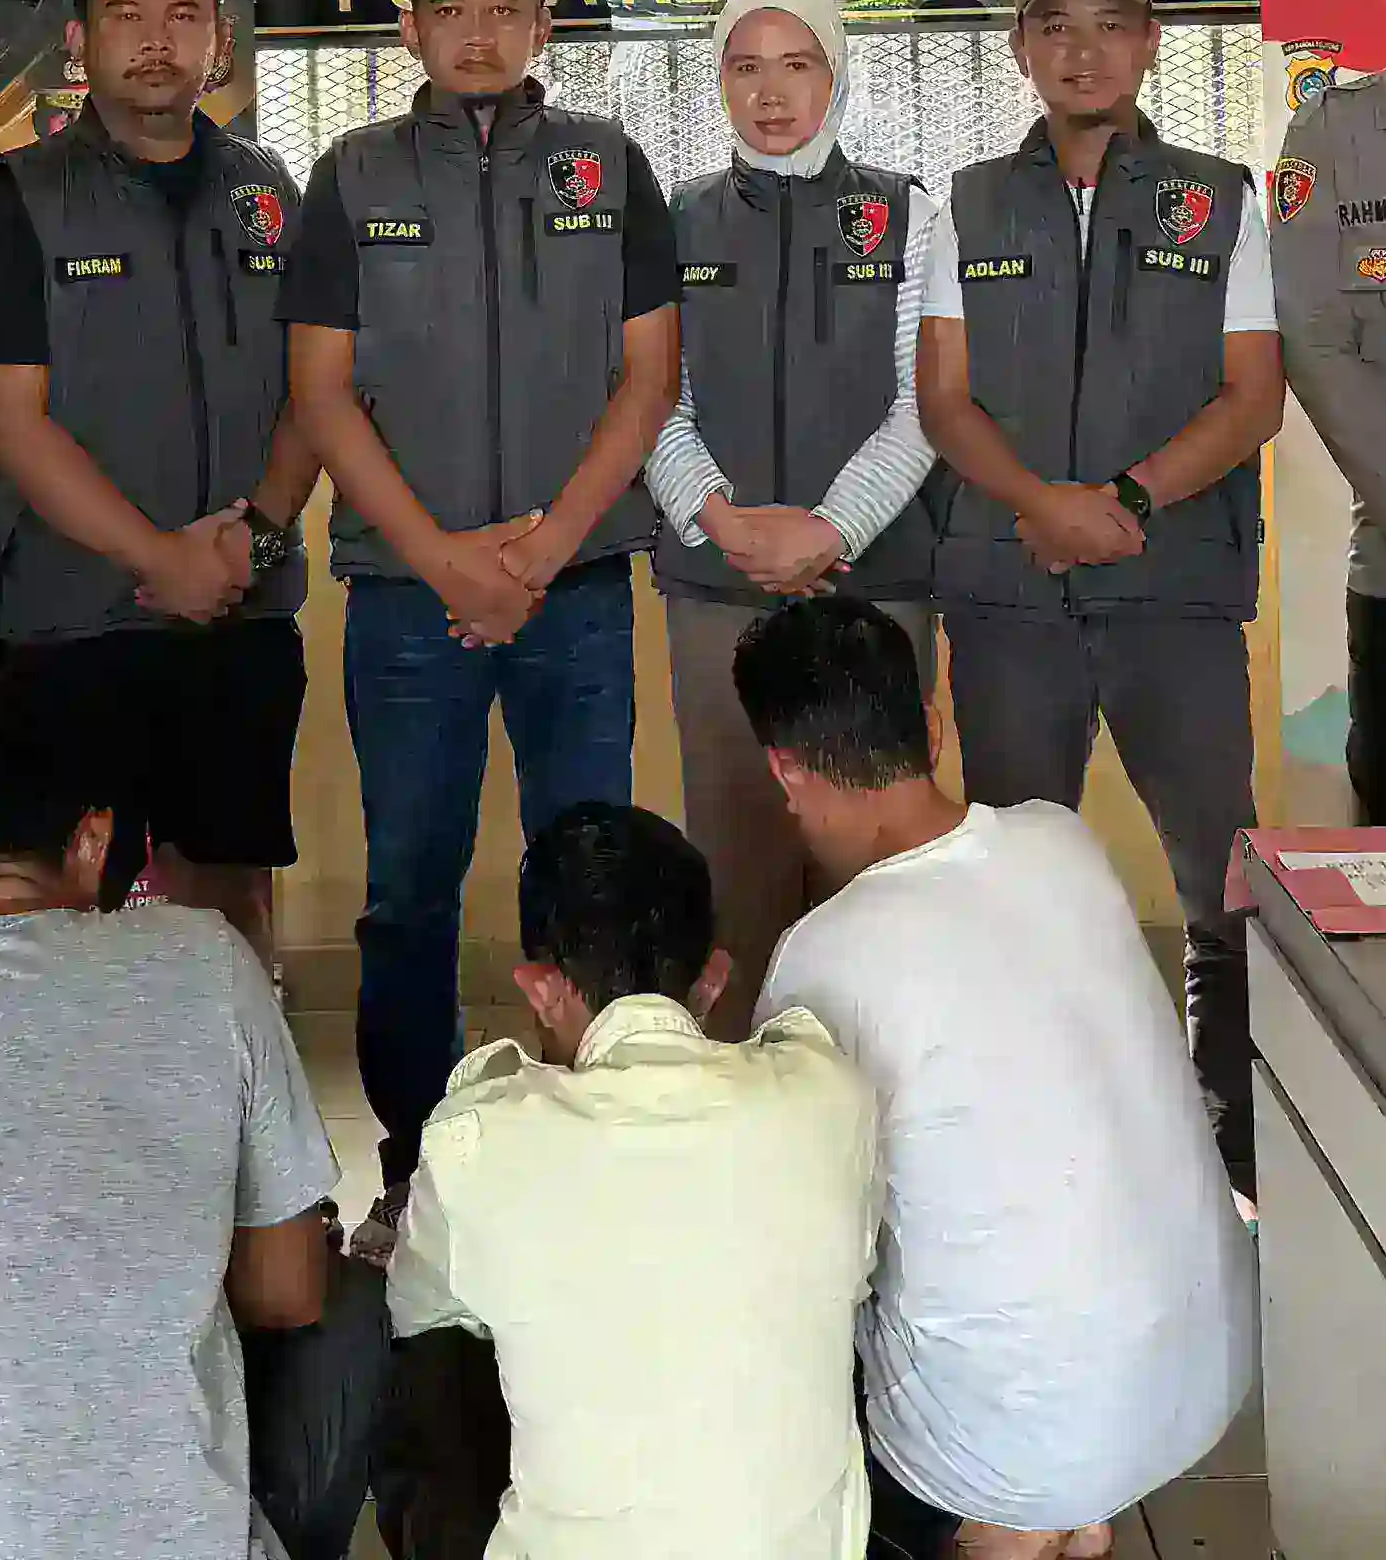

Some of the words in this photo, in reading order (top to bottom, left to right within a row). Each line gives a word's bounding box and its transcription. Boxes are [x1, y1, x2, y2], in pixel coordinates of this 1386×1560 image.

[367, 222, 421, 239] TIZAR
[553, 214, 590, 231] SUB
[595, 213, 612, 230] III
[67, 258, 121, 276] FIKRAM
[248, 255, 275, 271] SUB
[965, 258, 1025, 278] ADLAN
[1145, 248, 1185, 271] SUB
[1189, 256, 1210, 275] III
[847, 264, 875, 280] SUB
[878, 263, 893, 279] III
